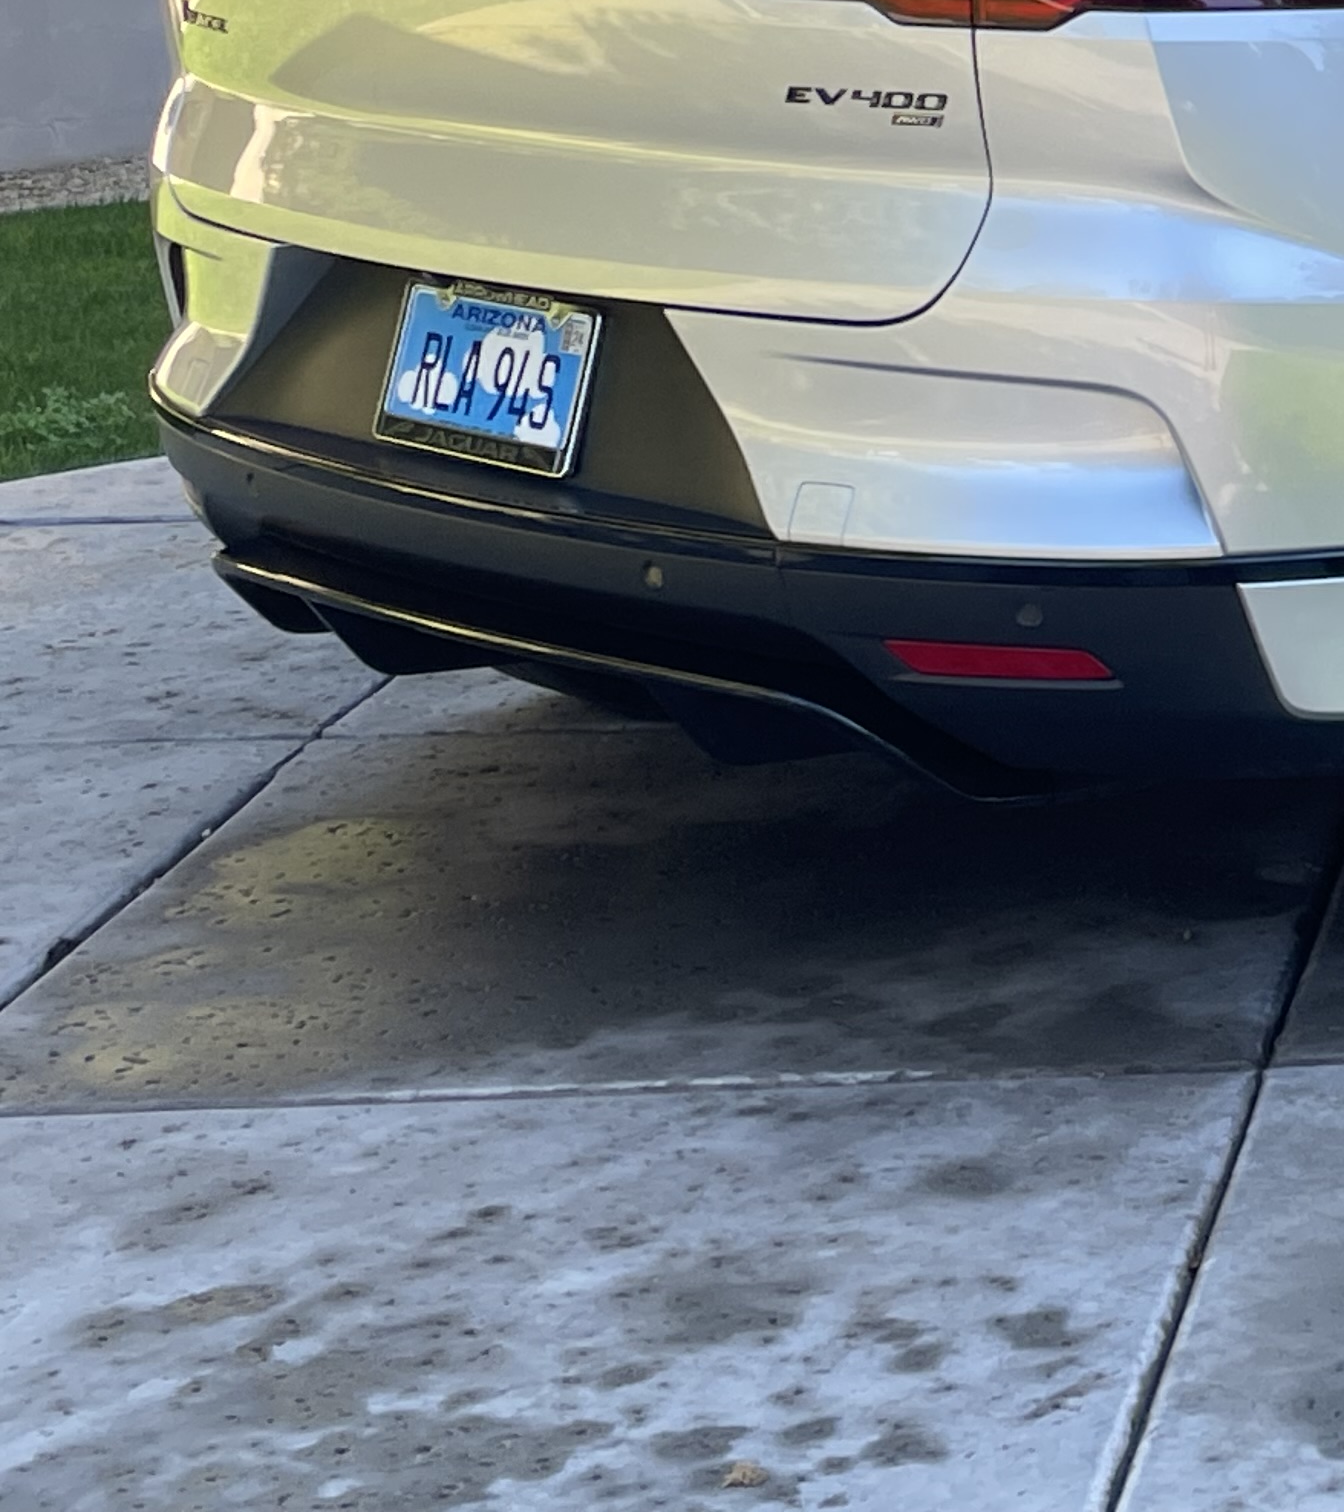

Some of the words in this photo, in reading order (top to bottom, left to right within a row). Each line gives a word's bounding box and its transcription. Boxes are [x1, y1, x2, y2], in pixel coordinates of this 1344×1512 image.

[785, 86, 948, 110] EV400
[452, 304, 547, 333] ARIZONA
[415, 428, 517, 462] JAGUAR
